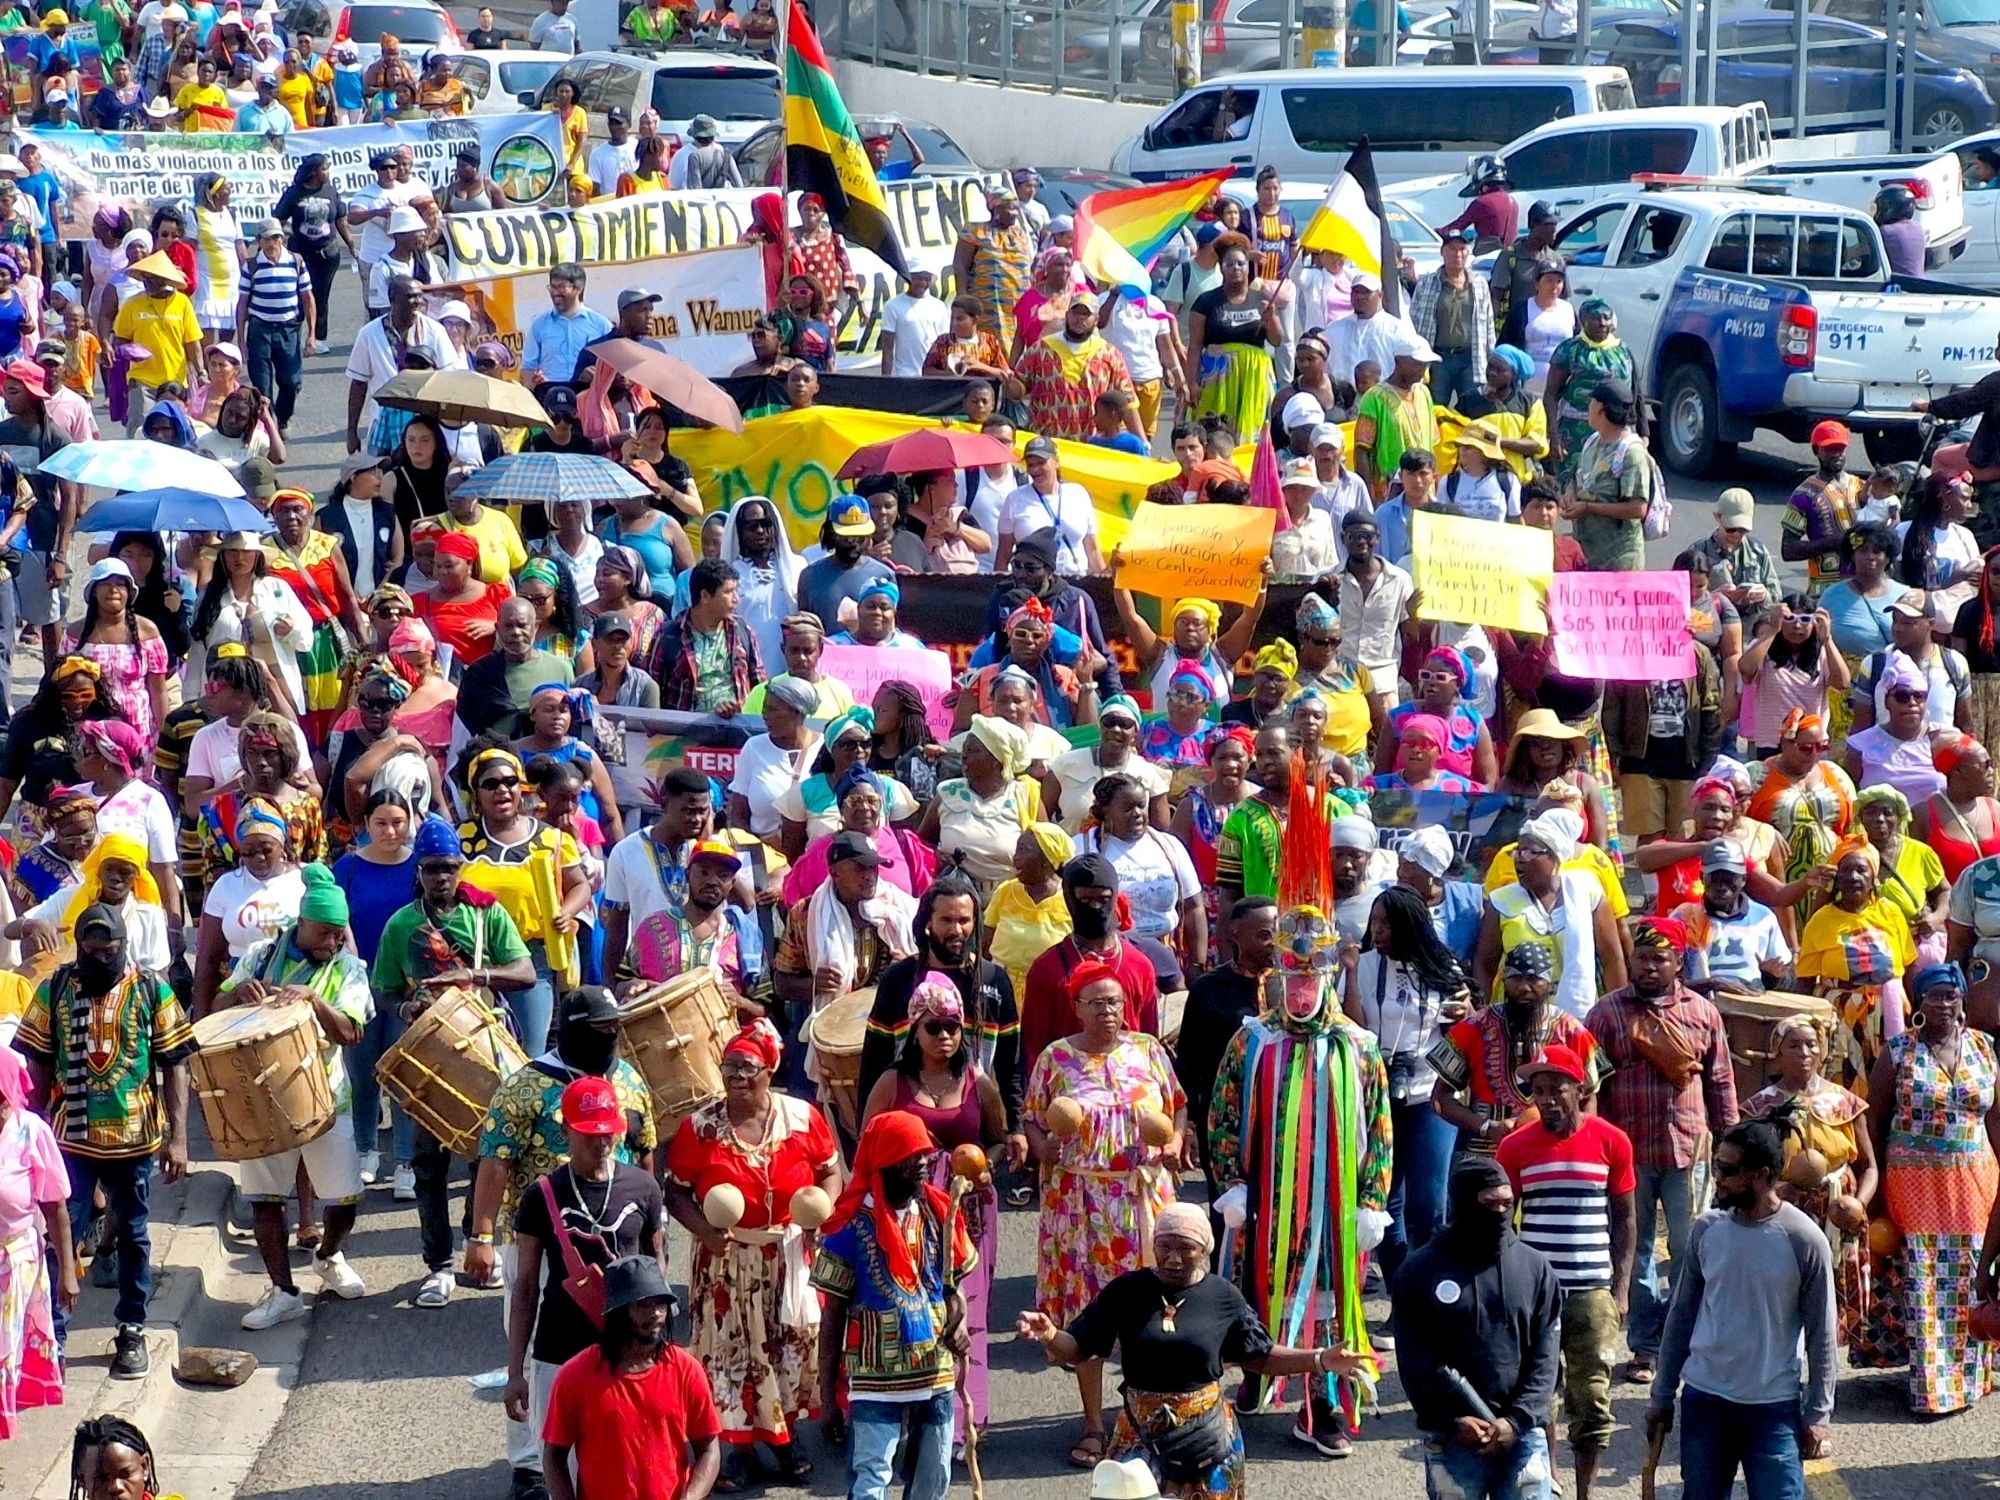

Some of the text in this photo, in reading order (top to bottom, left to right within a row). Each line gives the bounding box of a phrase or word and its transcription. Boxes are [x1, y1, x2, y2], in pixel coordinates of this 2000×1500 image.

[91, 152, 111, 169] No
[157, 152, 233, 171] violación
[238, 156, 248, 171] a
[252, 153, 276, 171] los
[110, 177, 157, 198] parte
[161, 176, 183, 196] de
[449, 198, 741, 267] CUMPLIMIENTO
[1693, 287, 1770, 312] SERVIR Y PROTEGER
[1724, 318, 1766, 339] PN-1120
[1818, 322, 1884, 334] EMERGENCIA
[1829, 332, 1868, 351] 911
[1942, 346, 1995, 362] PN-112
[1559, 583, 1582, 608] No
[686, 751, 738, 773] TER
